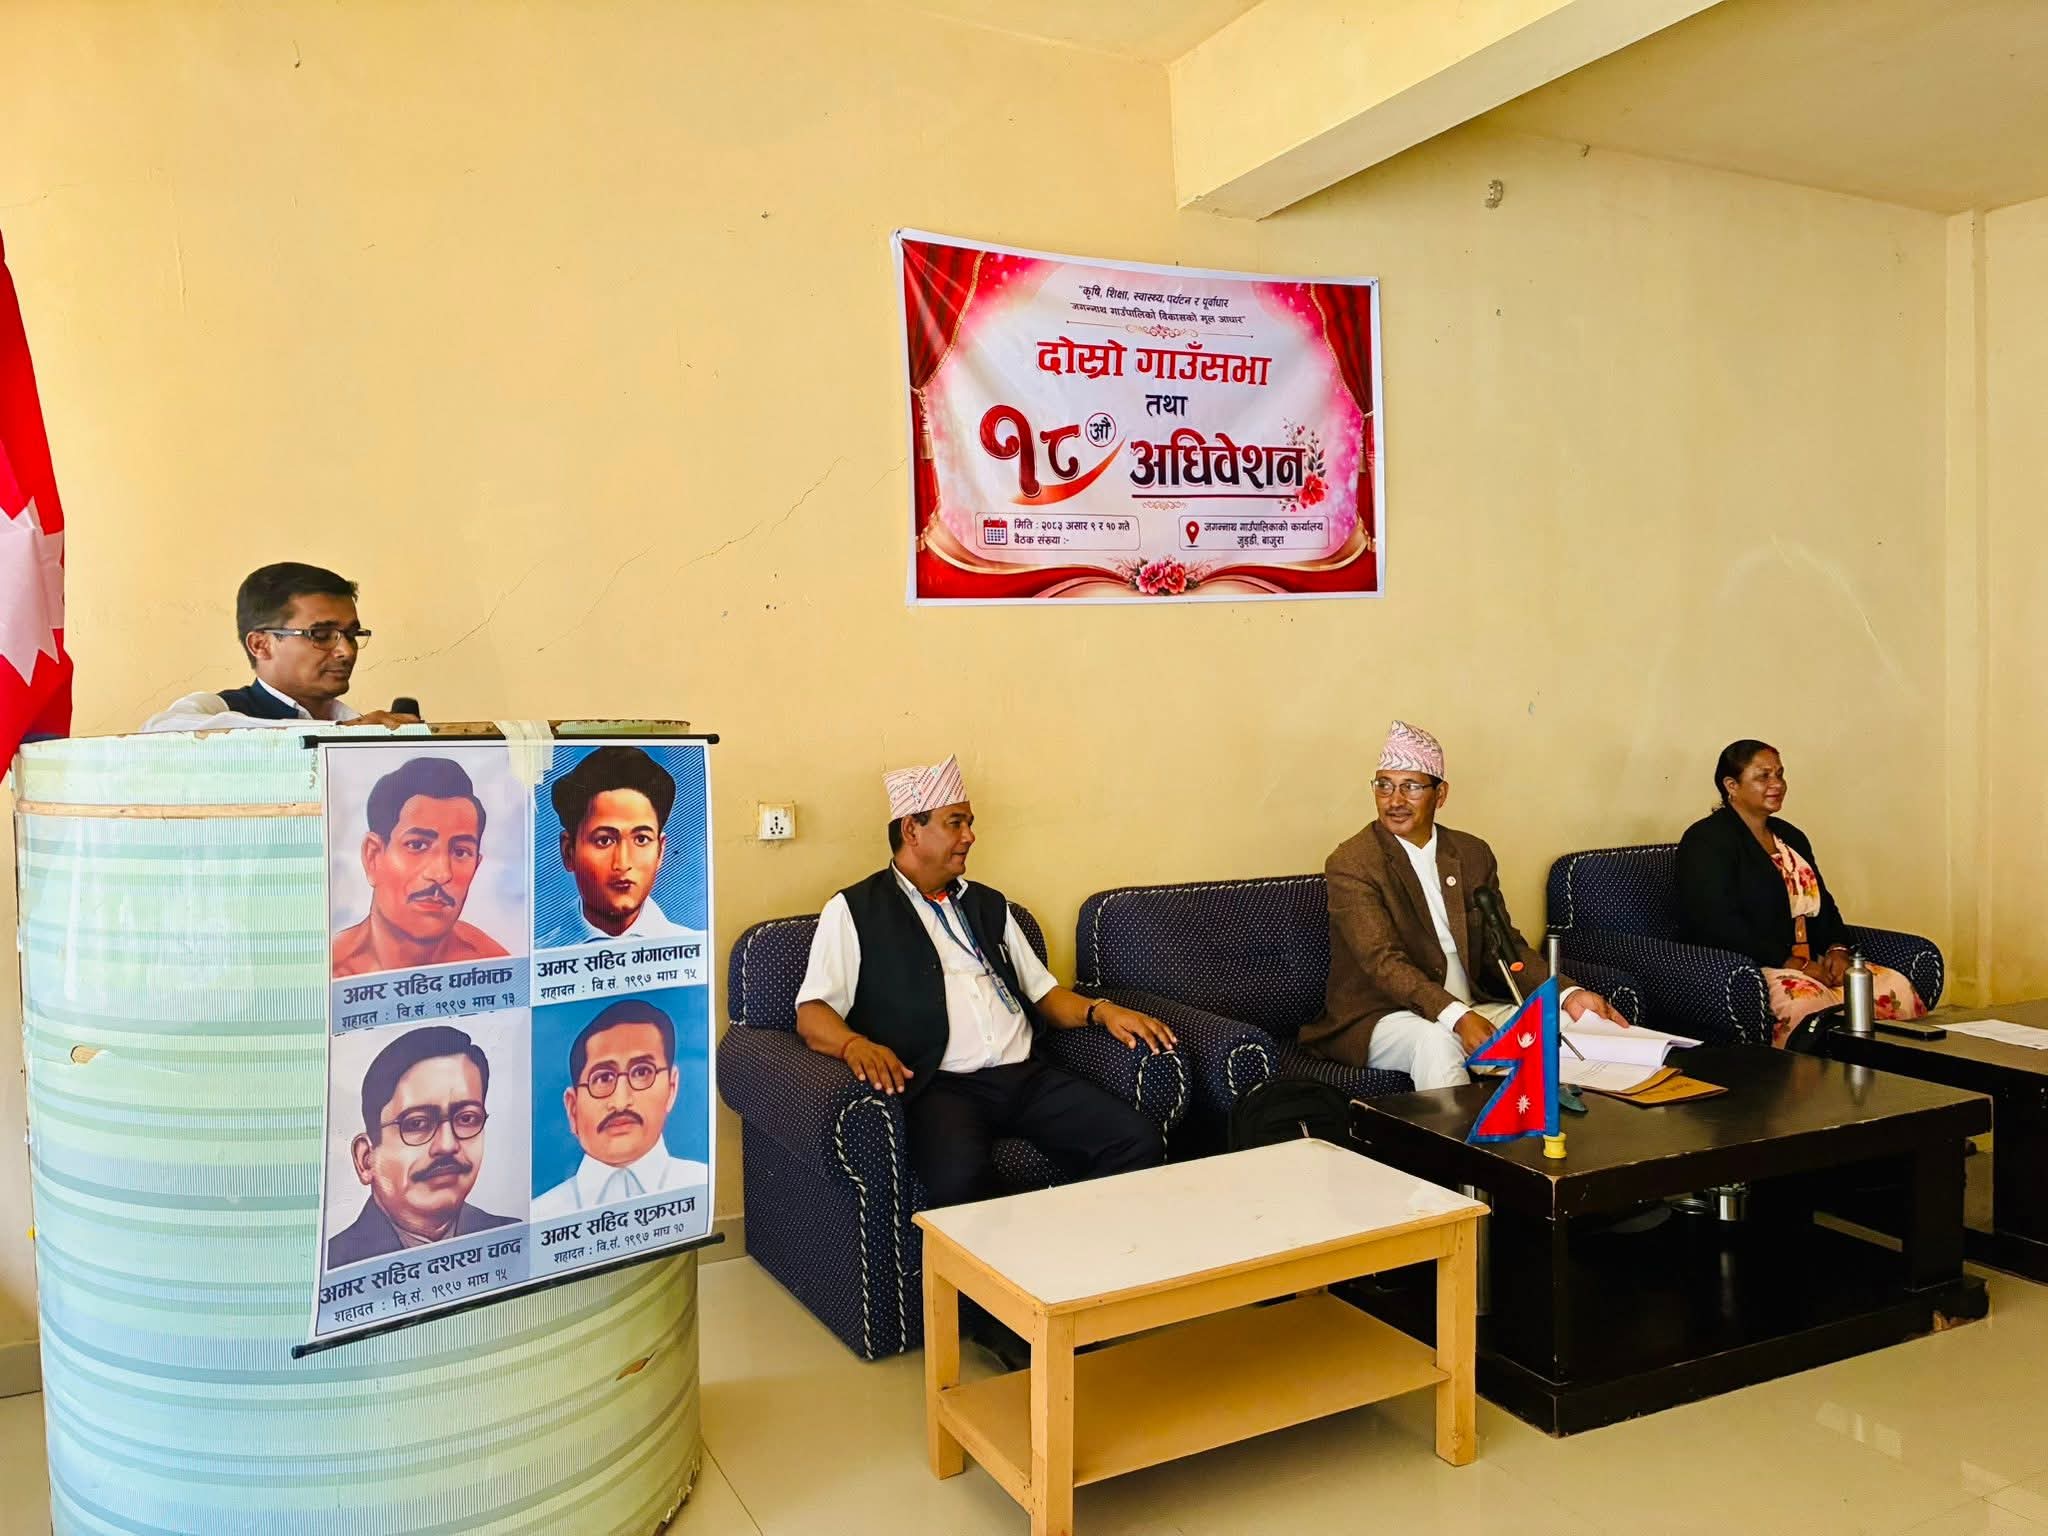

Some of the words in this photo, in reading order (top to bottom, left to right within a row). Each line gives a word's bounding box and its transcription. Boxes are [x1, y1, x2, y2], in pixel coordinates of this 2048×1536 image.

[1036, 335, 1128, 379] दोस्रो
[1135, 341, 1273, 386] गाउँसभा
[1145, 394, 1188, 416] तथा
[979, 404, 1081, 497] १८
[1130, 427, 1306, 488] अधिवेशन
[1014, 518, 1033, 530] मिति
[1041, 520, 1063, 532] २०८३
[1065, 521, 1088, 531] असार
[1098, 522, 1103, 531] र
[1014, 532, 1034, 545] बैठक
[1291, 520, 1324, 532] कार्यालय
[537, 957, 579, 978] अमर
[584, 950, 628, 972] सहिद
[631, 943, 701, 965] गंगालाल
[343, 982, 388, 1005] अमर
[393, 973, 444, 997] सहिद
[540, 984, 576, 1000] शहादत
[624, 975, 652, 987] १९९७
[657, 970, 678, 982] माघ
[684, 968, 697, 979] १५
[341, 1010, 378, 1030] शहादत
[435, 999, 466, 1015] १९९७
[472, 994, 496, 1008] माघ
[541, 1223, 582, 1247] अमर
[586, 1211, 630, 1236] सहिद
[634, 1196, 696, 1227] शुक्रराज
[554, 1247, 585, 1265] शहादत
[624, 1232, 650, 1247] १९९७
[653, 1224, 671, 1238] माघ
[673, 1223, 684, 1234] १०
[319, 1276, 366, 1304] अमर
[371, 1261, 422, 1289] सहिद
[427, 1247, 484, 1275] दशरथ
[487, 1237, 523, 1258] चन्द
[334, 1302, 374, 1323] शहादत
[431, 1280, 462, 1299] १९९७
[467, 1272, 490, 1288] माघ
[495, 1267, 508, 1280] १५
